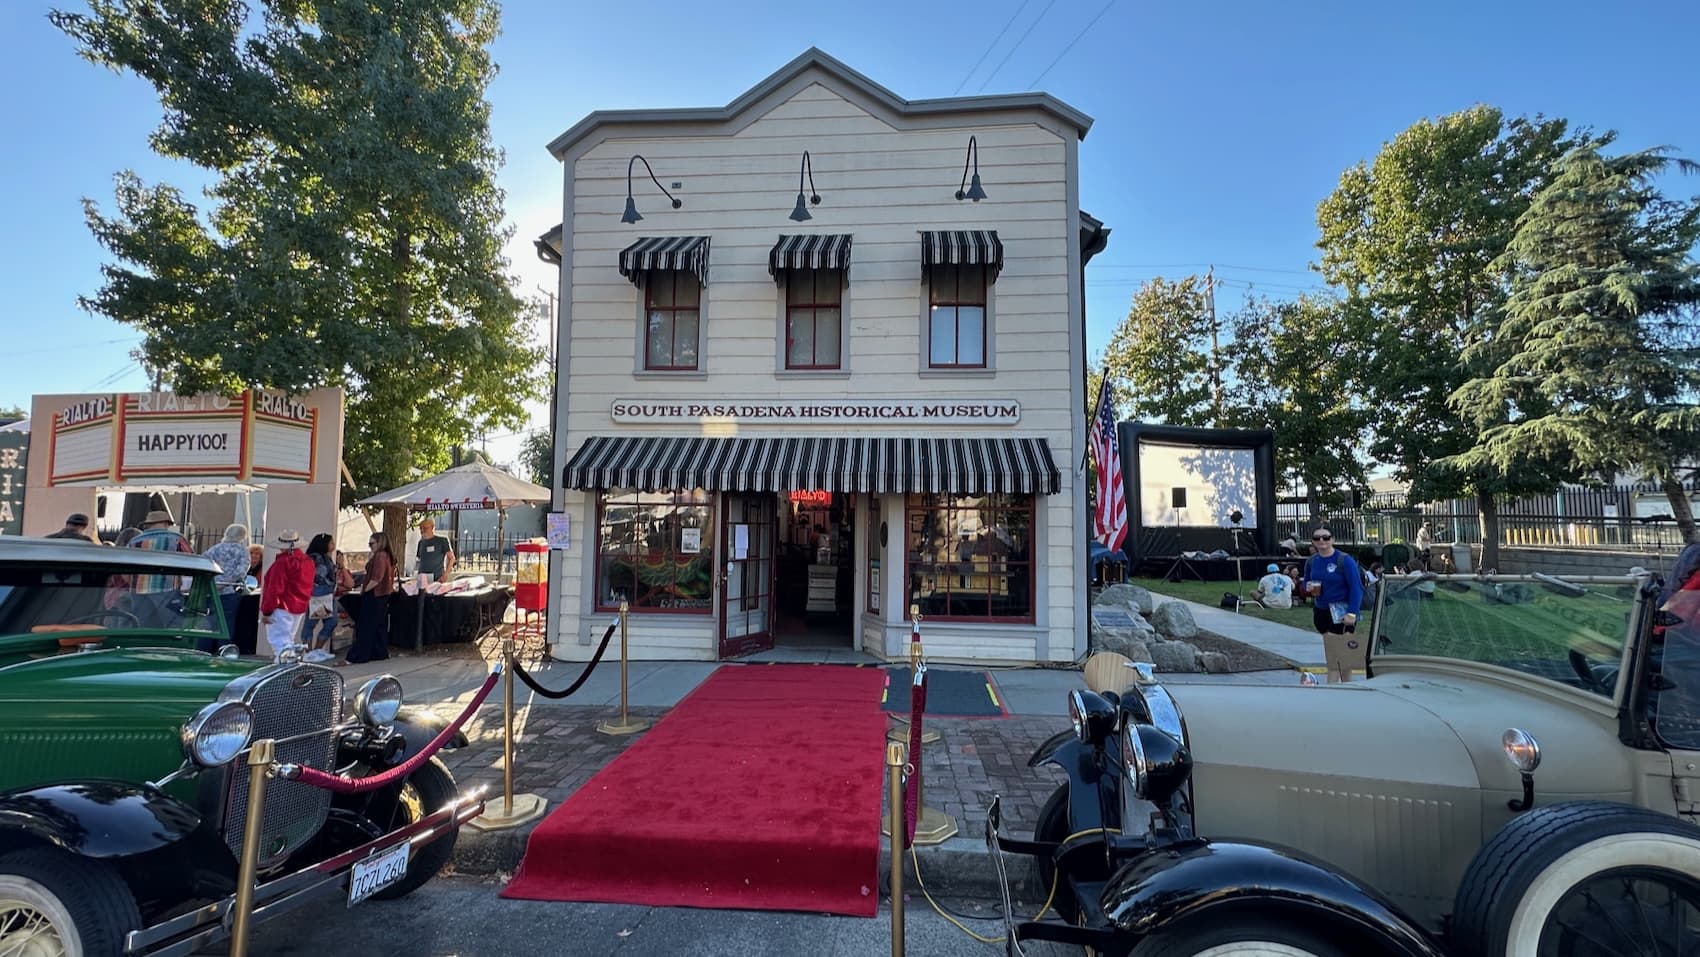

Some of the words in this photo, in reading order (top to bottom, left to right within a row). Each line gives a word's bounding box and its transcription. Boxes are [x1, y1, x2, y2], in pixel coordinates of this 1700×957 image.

[62, 397, 108, 425] RIALTO
[262, 391, 307, 420] RIALTO
[613, 404, 682, 417] SOUTH
[687, 404, 797, 418] PASADENA
[800, 405, 919, 418] HISTORICAL
[922, 404, 1018, 418] MUSEUM
[138, 433, 196, 452] HAPPY
[197, 433, 228, 451] 100!
[426, 502, 450, 511] RIALTO
[354, 856, 406, 900] 7CZL260
